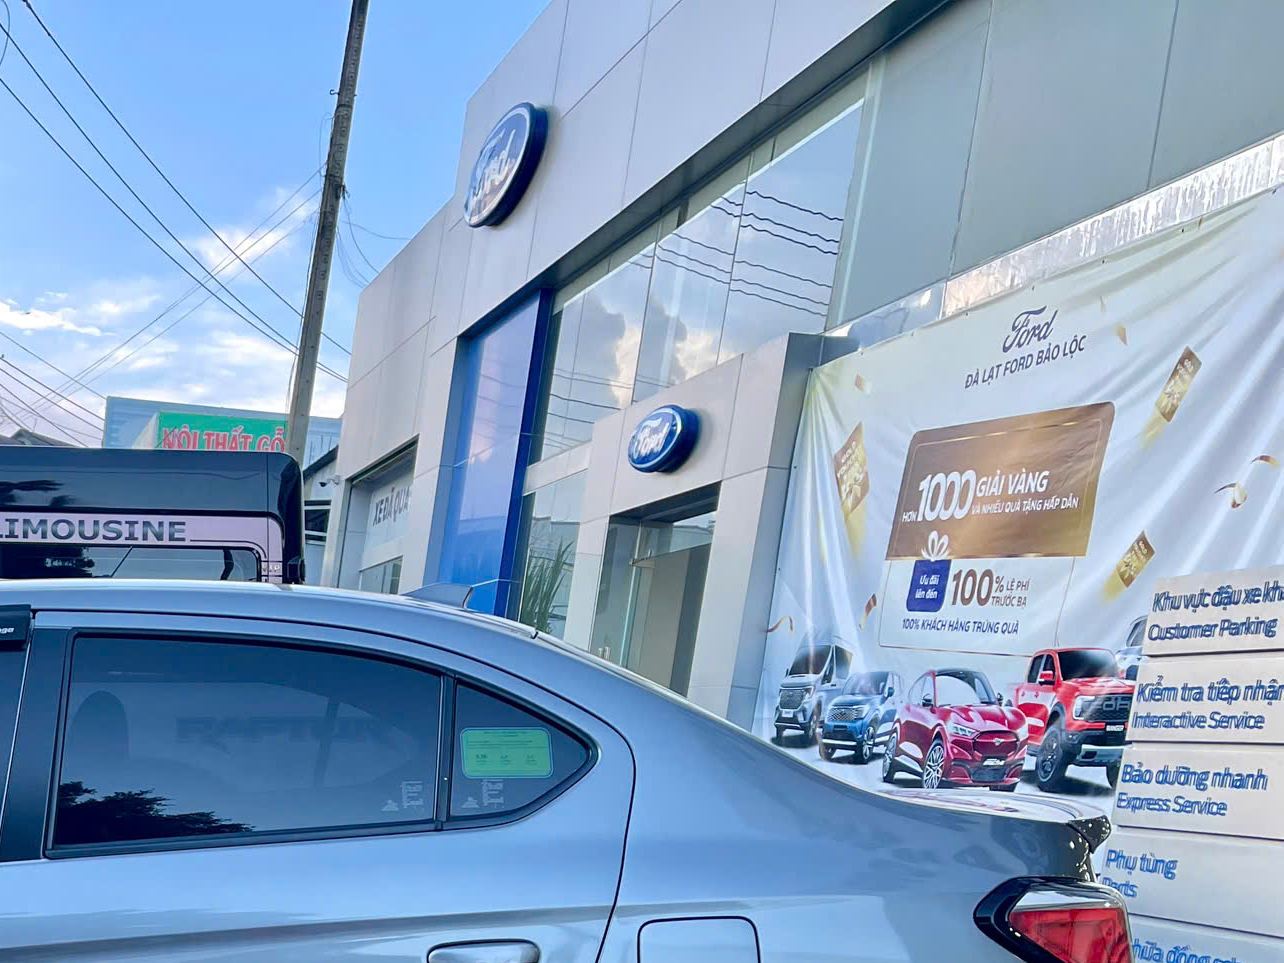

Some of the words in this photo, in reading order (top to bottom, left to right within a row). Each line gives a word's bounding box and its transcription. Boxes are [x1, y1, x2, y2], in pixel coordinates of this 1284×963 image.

[1002, 305, 1059, 353] Ford
[965, 368, 979, 389] ĐÀ
[982, 363, 1002, 385] LẠT
[1003, 353, 1033, 377] FORD
[1036, 342, 1060, 366] BẢO
[1062, 334, 1087, 359] LỘC
[203, 425, 253, 451] THẤT
[257, 426, 285, 452] GỖ
[633, 416, 670, 460] Ford
[917, 470, 977, 522] 1000
[976, 470, 1005, 497] GIẢI
[1008, 468, 1050, 495] VÀNG
[1005, 500, 1021, 514] QUÀ
[1023, 498, 1042, 516] TẶNG
[1006, 579, 1015, 594] LỆ
[1016, 577, 1031, 592] PHÍ
[1153, 591, 1183, 613] Khu
[1183, 589, 1211, 613] vực
[1242, 587, 1262, 604] xe
[1262, 580, 1284, 603] kh
[991, 592, 1015, 607] TRƯỚC
[1017, 597, 1027, 609] BẠ
[902, 618, 920, 630] 100%
[920, 617, 947, 632] KHÁCH
[947, 617, 971, 633] HÀNG
[972, 620, 1000, 633] TRÚNG
[1001, 620, 1020, 634] QUÀ
[1148, 622, 1219, 641] Customer
[1219, 616, 1278, 638] Parking
[1136, 675, 1179, 702] Kiểm
[1183, 682, 1205, 702] tra
[1207, 677, 1241, 705] tiếp
[1131, 711, 1208, 730] Interactive
[1208, 711, 1265, 730] Service
[1121, 762, 1154, 785] Bảo
[1155, 765, 1211, 791] dưỡng
[1211, 769, 1268, 790] nhanh
[1116, 792, 1172, 814] Express
[1172, 795, 1228, 816] Service
[1106, 849, 1138, 875] Phụ
[1139, 852, 1178, 880] tùng
